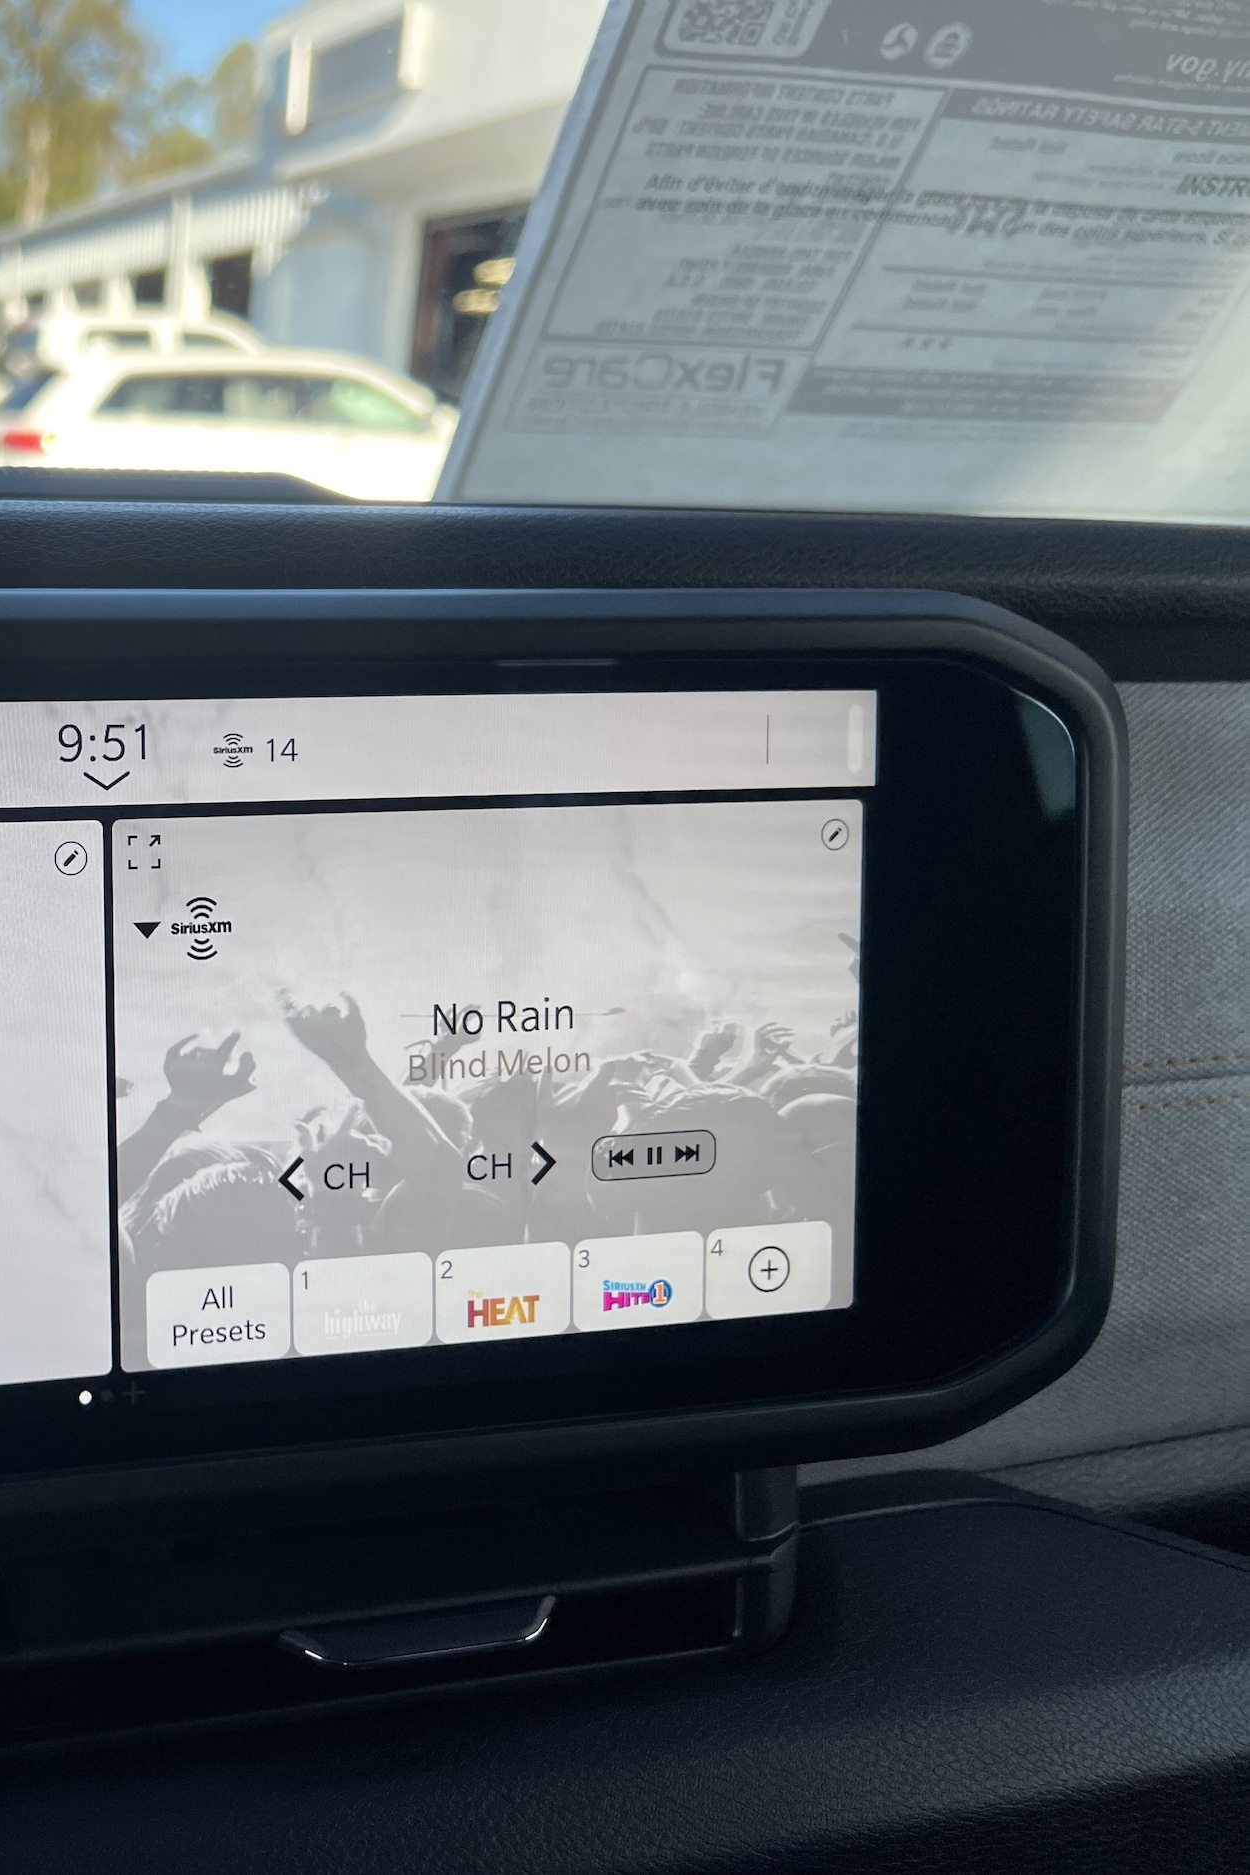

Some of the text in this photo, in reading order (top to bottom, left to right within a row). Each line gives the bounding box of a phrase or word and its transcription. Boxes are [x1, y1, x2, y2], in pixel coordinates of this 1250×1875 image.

[59, 724, 147, 764] 9:51
[268, 739, 297, 763] 14
[434, 998, 574, 1037] No Rain
[407, 1046, 592, 1082] Blind Melon
[324, 1162, 371, 1191] CH
[468, 1153, 513, 1182] CH
[580, 1250, 591, 1270] 3
[711, 1240, 724, 1258] 4
[300, 1270, 309, 1291] 1
[441, 1261, 454, 1281] 2
[203, 1286, 234, 1310] All
[467, 1294, 540, 1329] HEAT
[174, 1321, 267, 1348] Presets
[323, 1308, 402, 1338] highway
